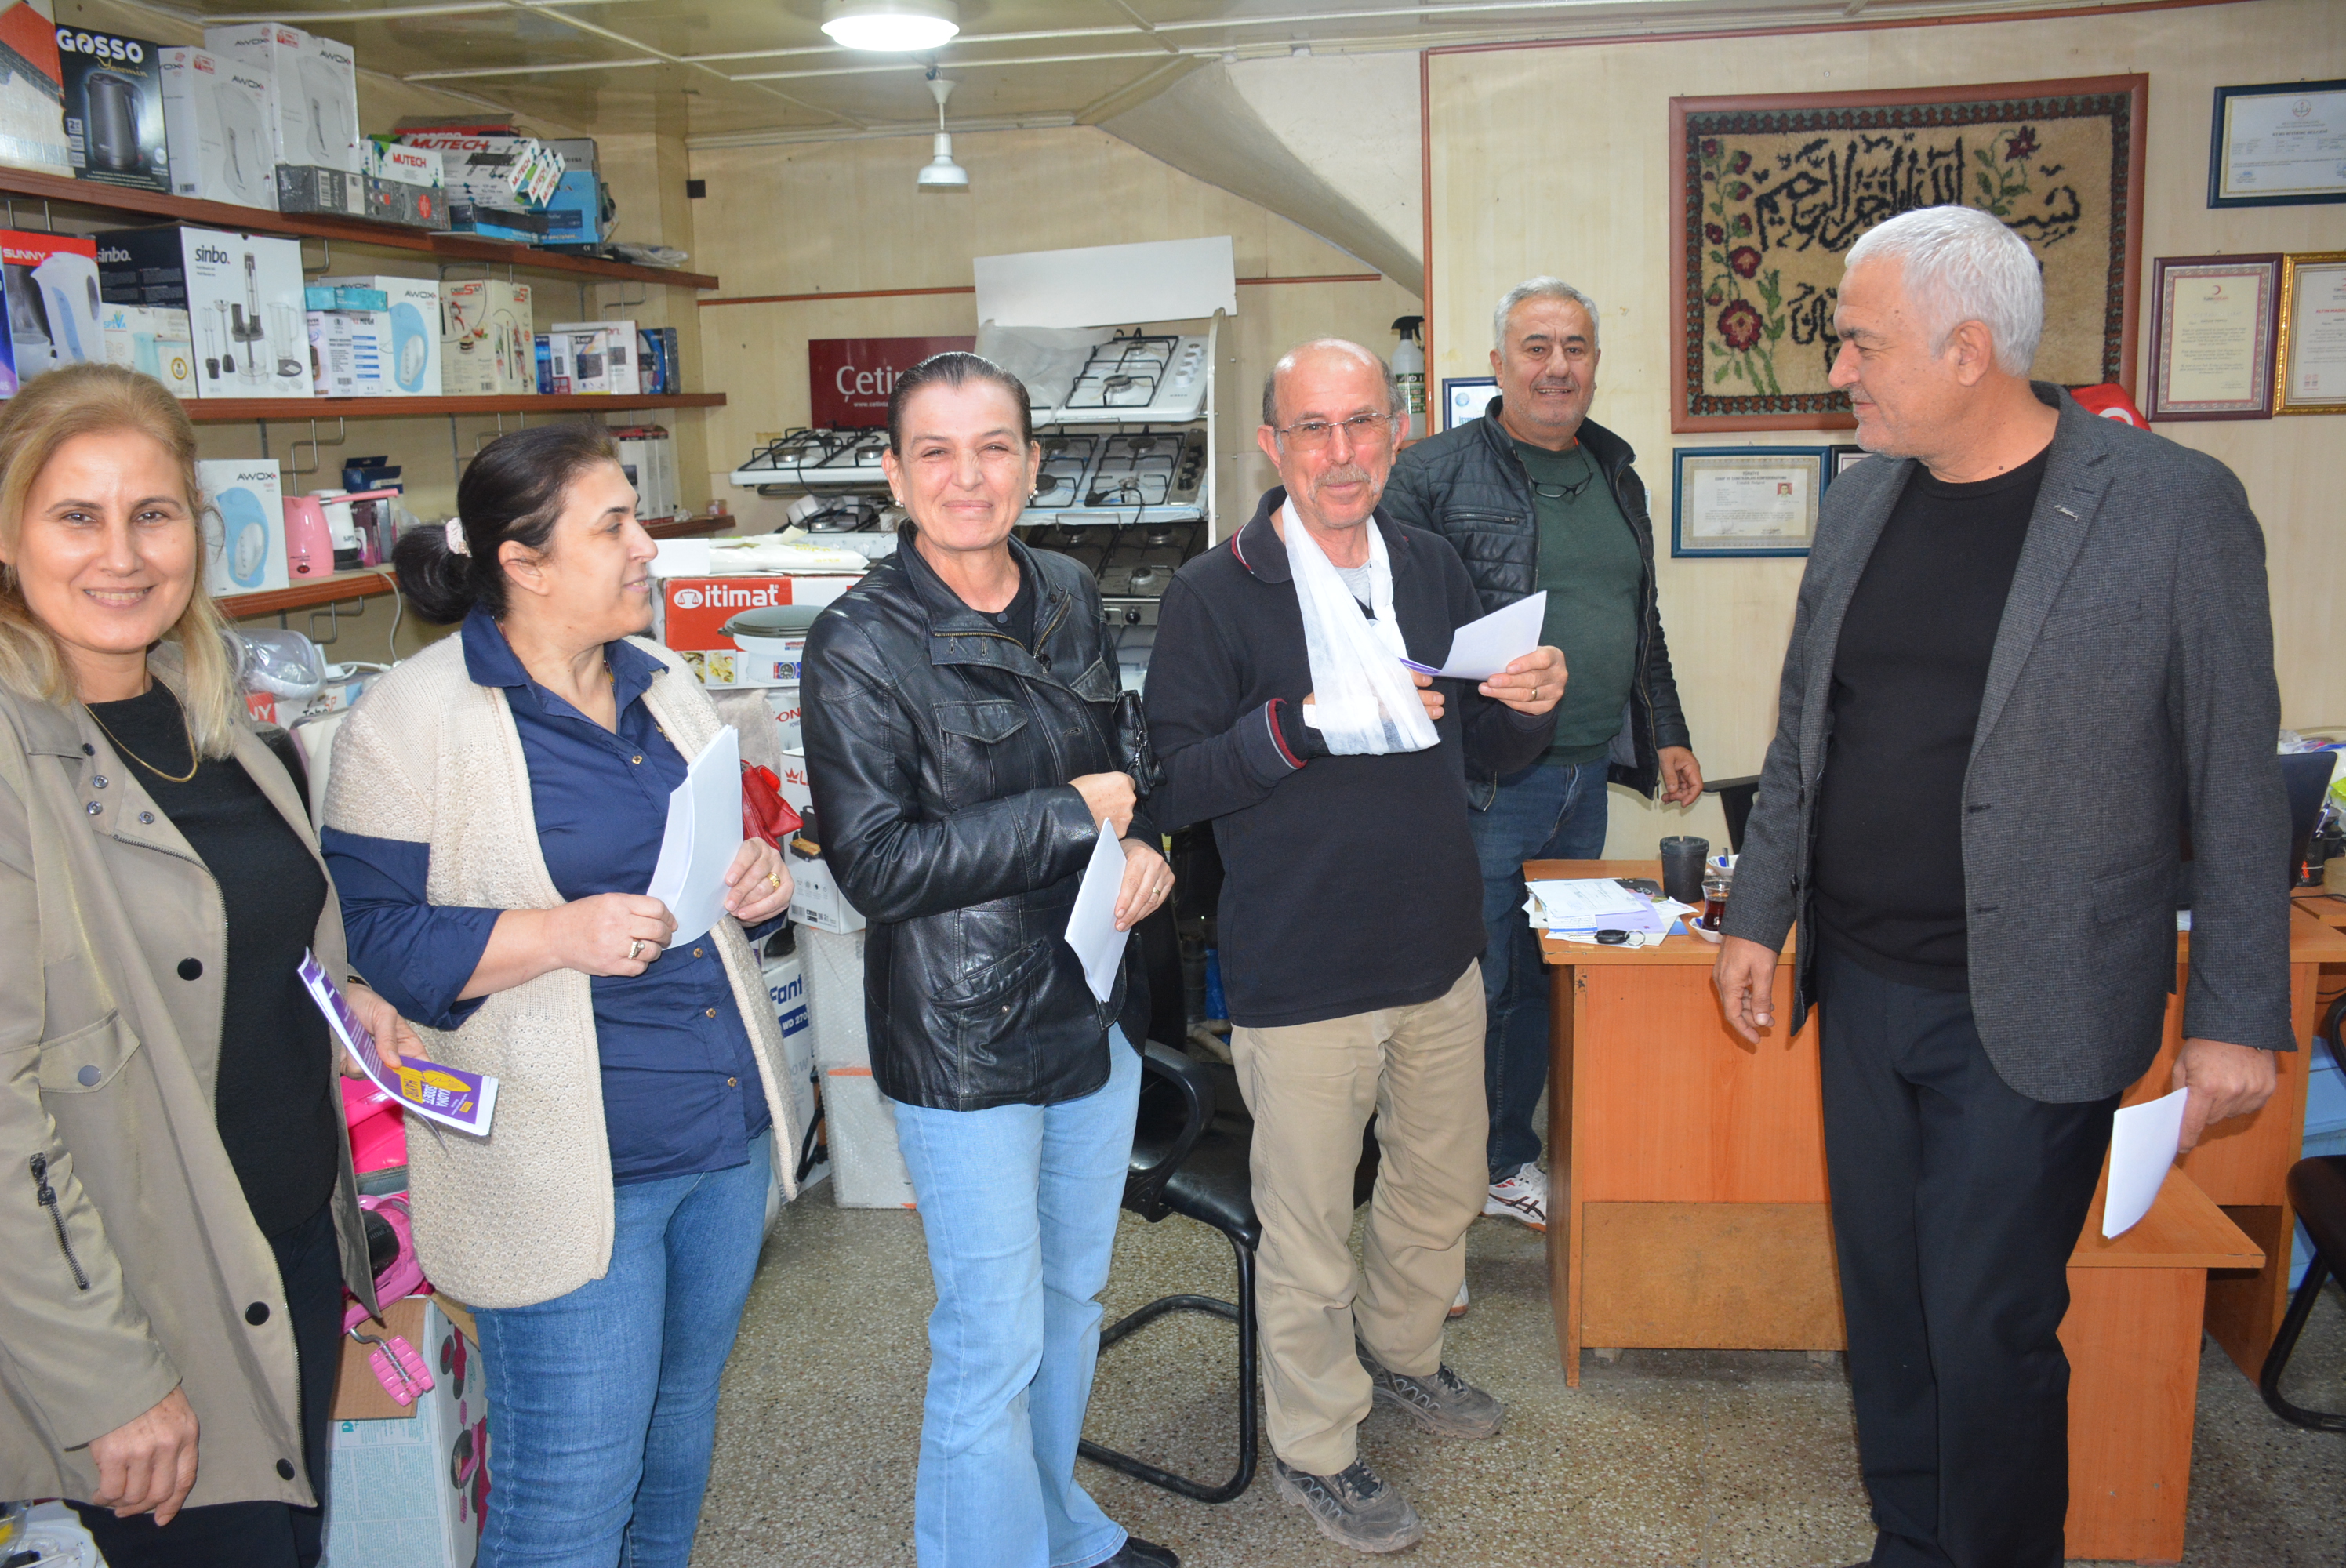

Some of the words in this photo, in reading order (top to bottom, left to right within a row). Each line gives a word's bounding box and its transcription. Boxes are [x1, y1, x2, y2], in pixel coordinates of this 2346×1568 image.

[56, 28, 144, 64] GOSSO
[320, 50, 350, 64] AWOX
[95, 56, 148, 78] Yasemin
[232, 75, 262, 90] AWOX
[410, 138, 489, 151] MUTECH
[393, 152, 427, 169] MUTECH
[512, 157, 531, 186] MUTECH
[531, 166, 546, 196] MUTECH
[543, 172, 557, 201] MUTECH
[3, 248, 46, 261] SUNNY
[404, 290, 434, 299] AWOX
[237, 472, 273, 481] AWOX
[706, 584, 779, 608] itimat
